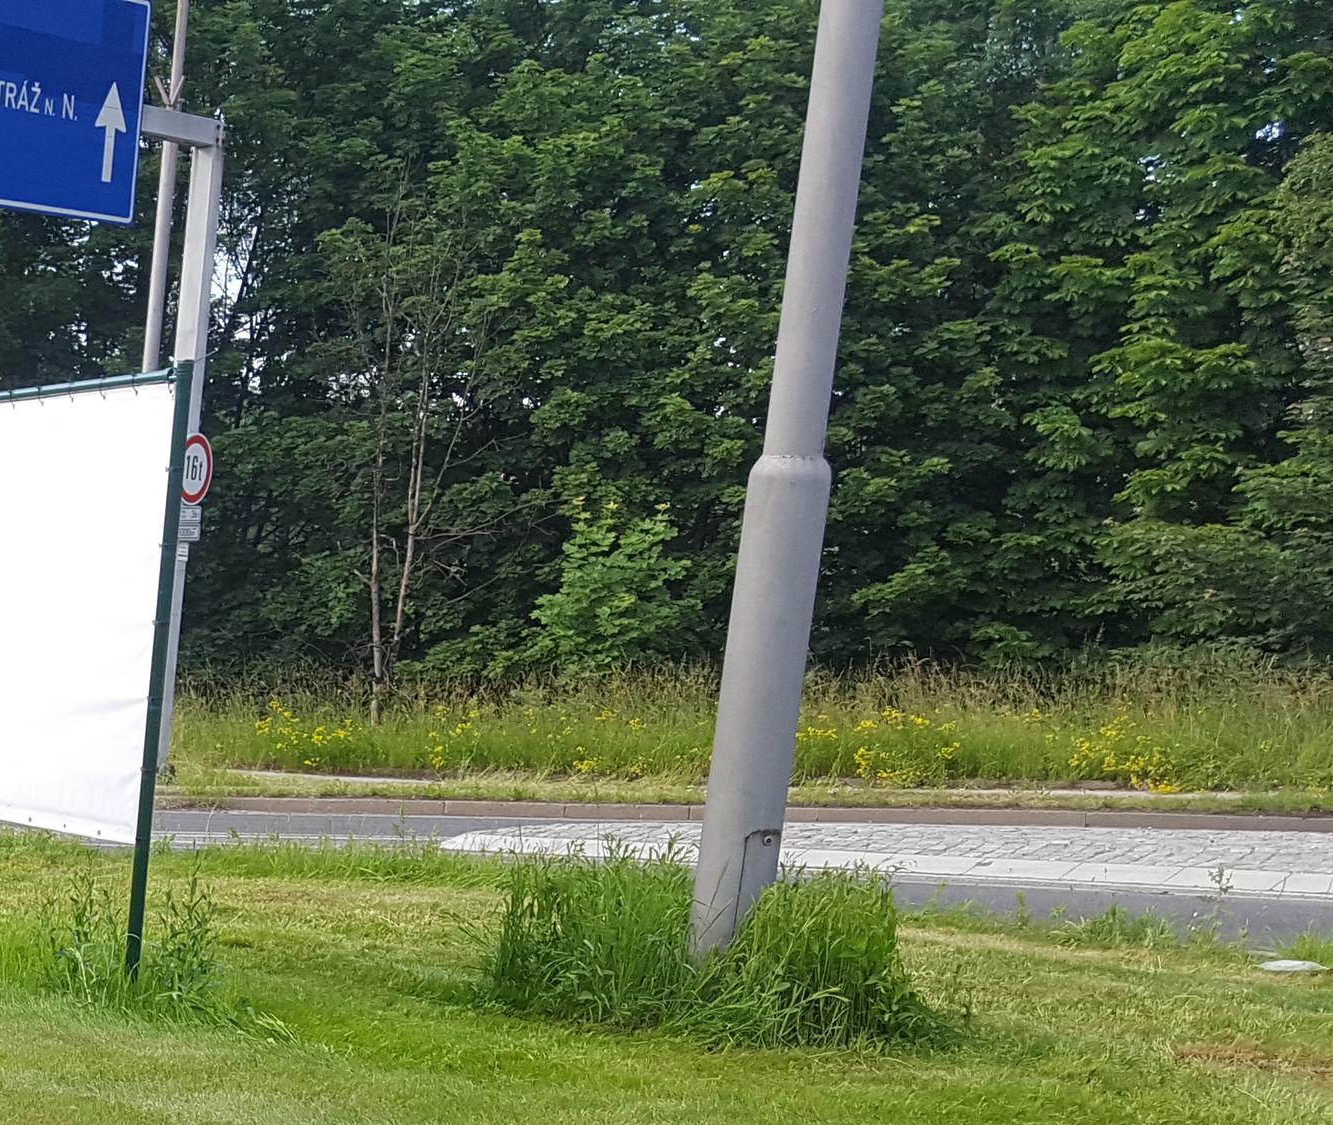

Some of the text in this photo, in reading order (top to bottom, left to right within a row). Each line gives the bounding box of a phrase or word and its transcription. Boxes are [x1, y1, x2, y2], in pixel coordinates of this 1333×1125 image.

[44, 98, 56, 117] N.
[62, 92, 78, 121] N.
[185, 454, 204, 482] 16t
